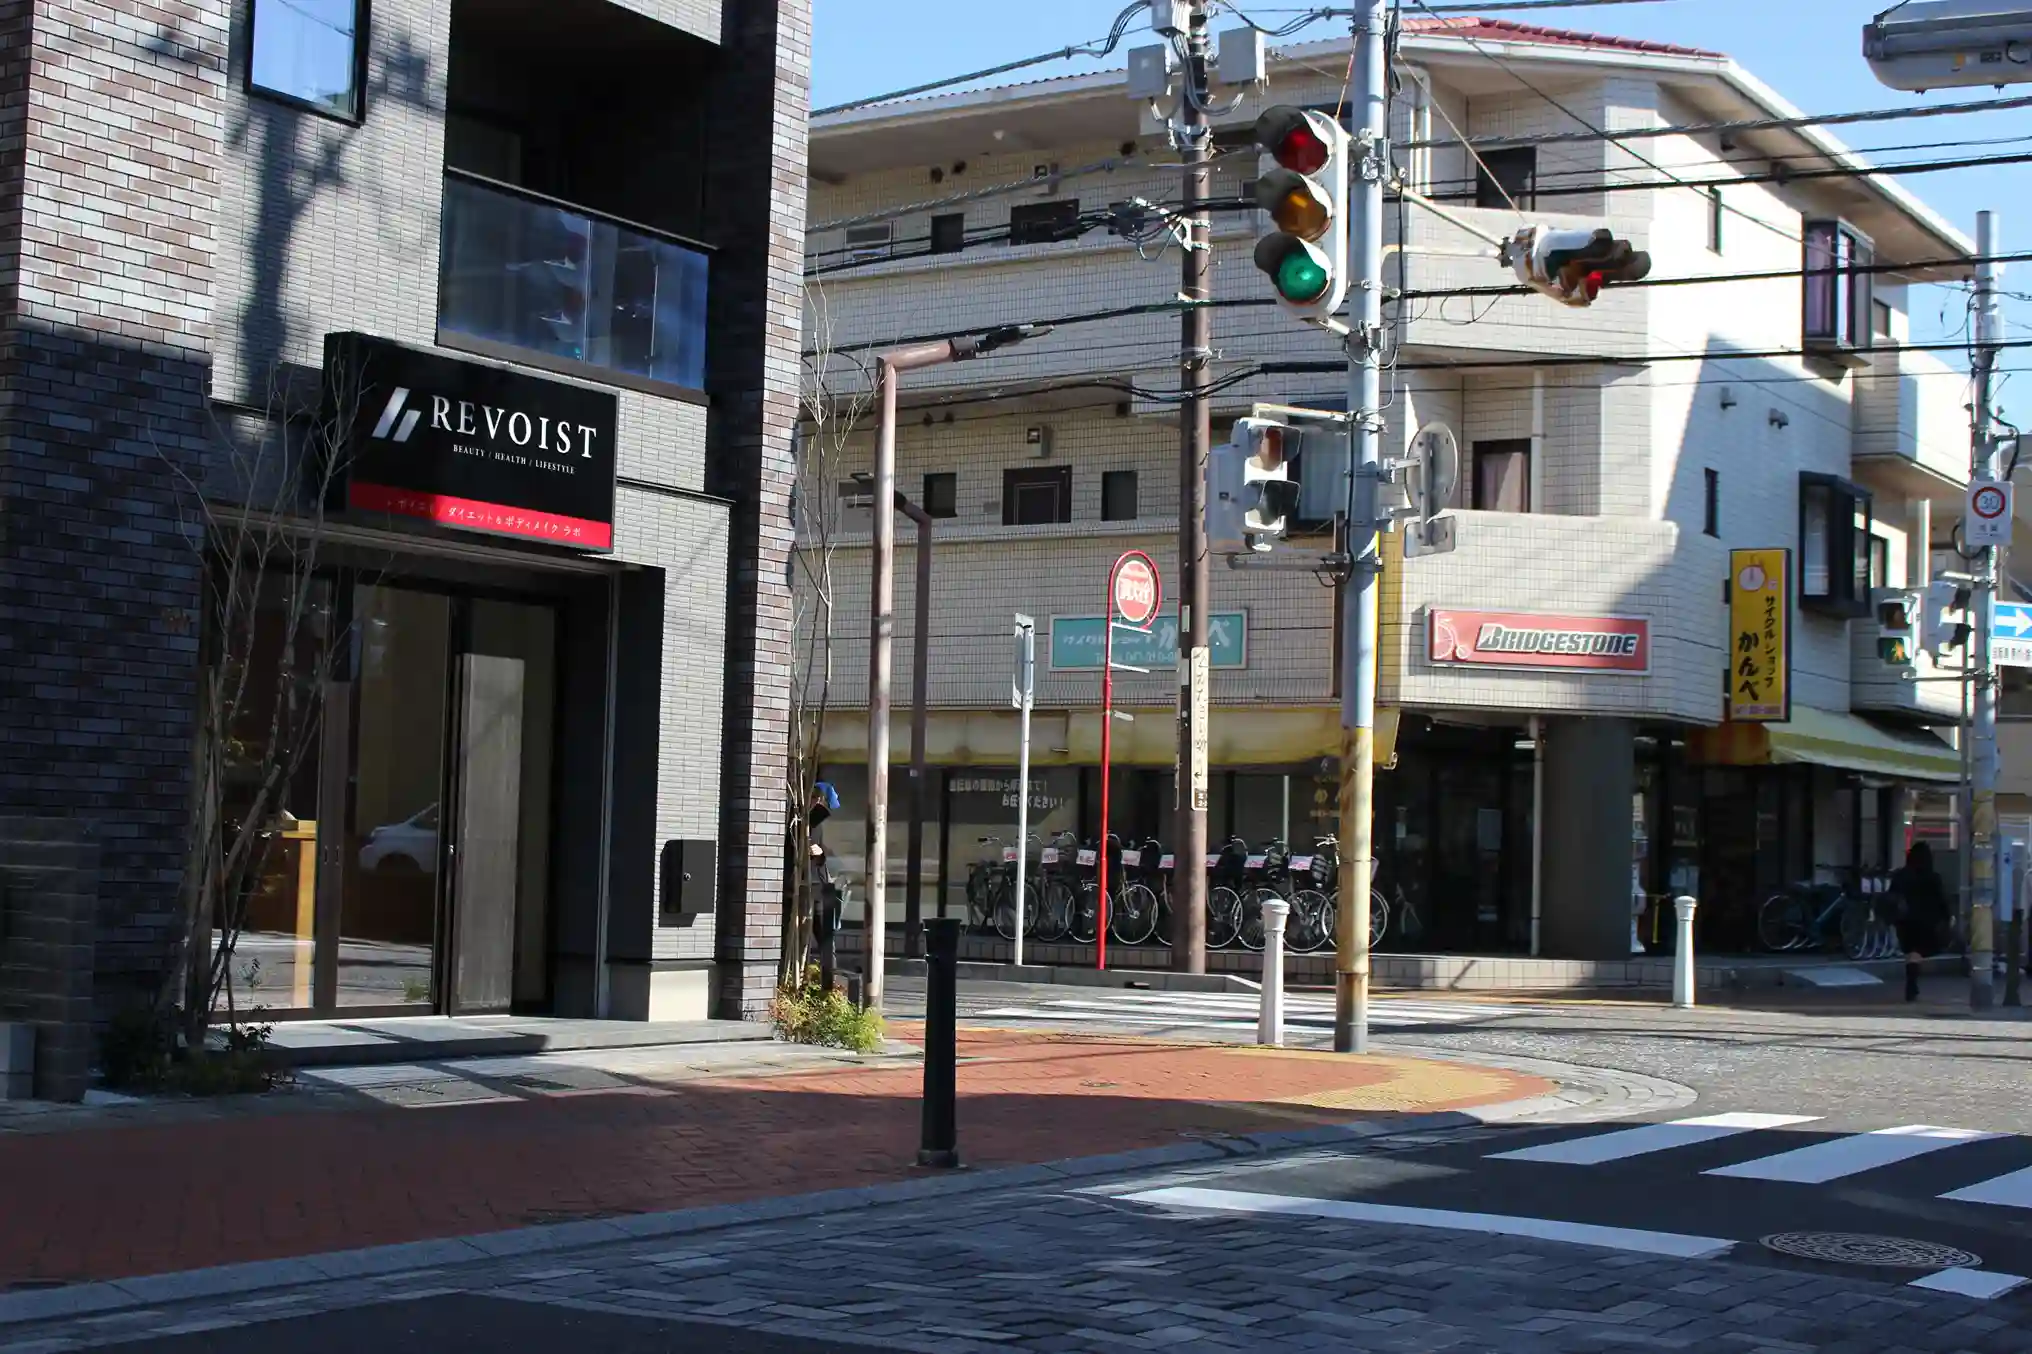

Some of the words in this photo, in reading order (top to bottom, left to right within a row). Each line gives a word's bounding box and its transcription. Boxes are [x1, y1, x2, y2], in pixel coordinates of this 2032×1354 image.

[431, 395, 597, 458] REVOIST
[453, 444, 485, 457] BEAUTY
[495, 452, 527, 466] HEALTH
[535, 459, 575, 475] LIFESTYLE
[1981, 495, 2000, 510] 30
[1476, 624, 1640, 656] BRIDGESTONE
[1738, 631, 1759, 702] かんべ
